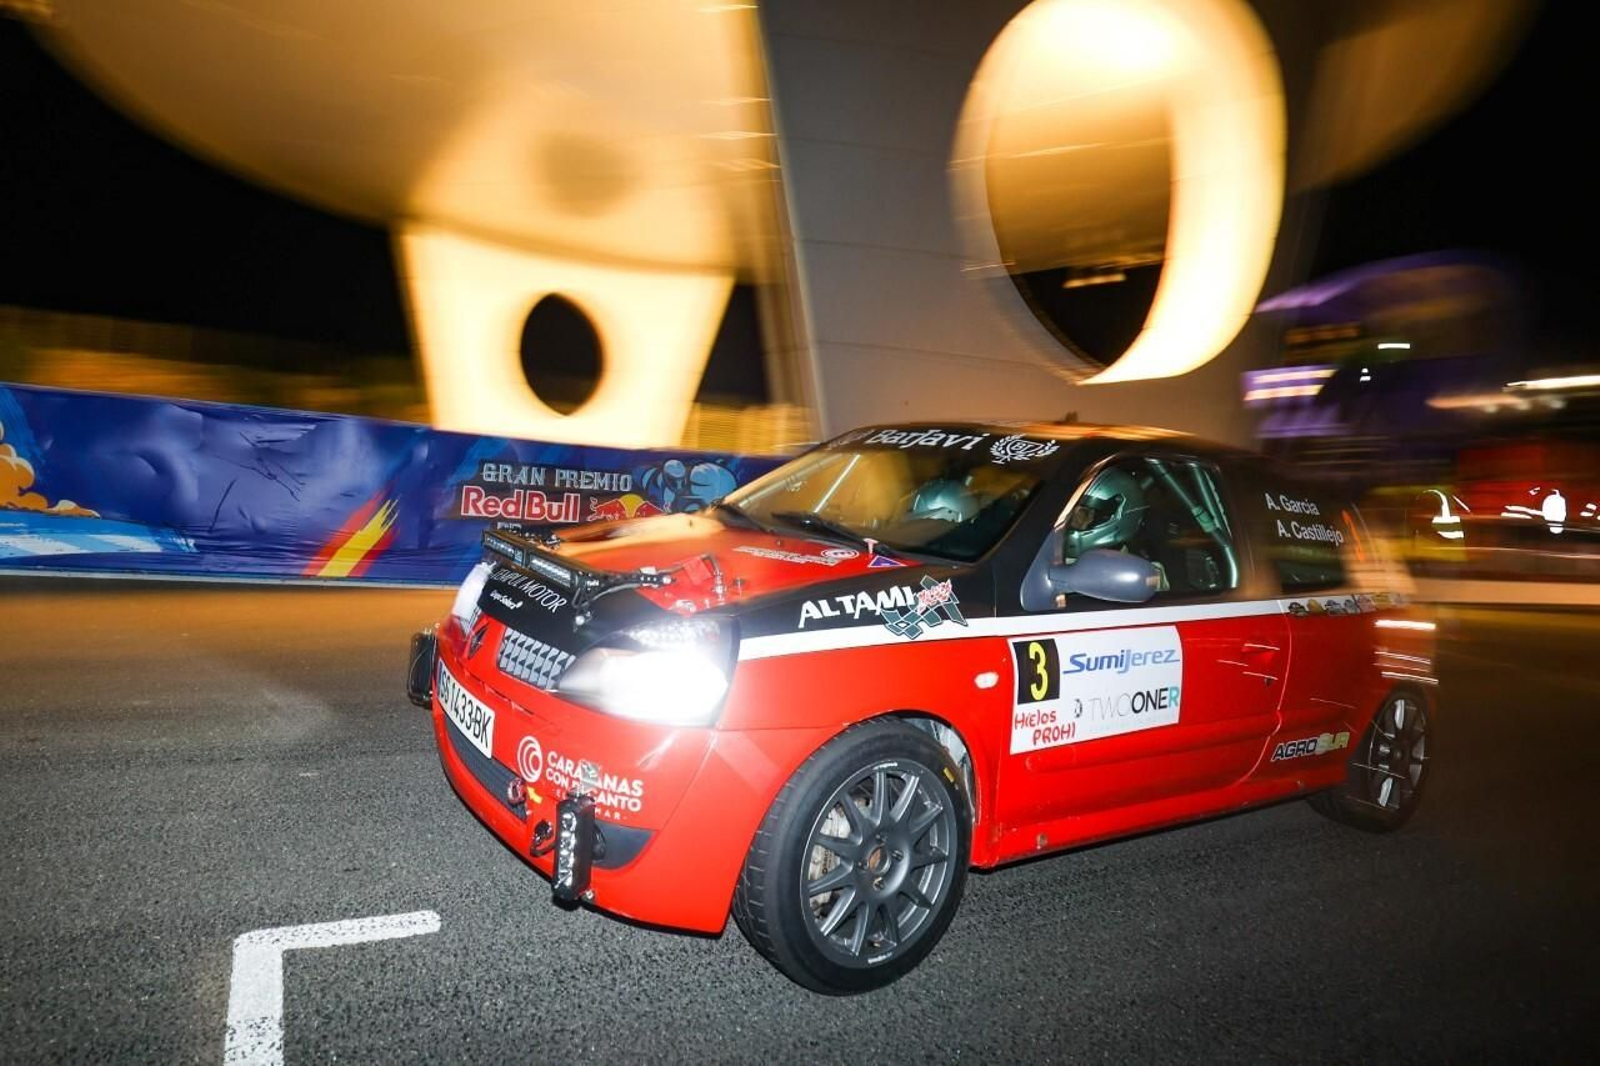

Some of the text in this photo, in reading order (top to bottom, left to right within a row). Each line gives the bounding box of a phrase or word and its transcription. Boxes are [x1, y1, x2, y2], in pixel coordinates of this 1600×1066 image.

[483, 463, 632, 492] GRAN PREMIO
[461, 485, 580, 523] Red Bull
[1265, 493, 1280, 511] A.
[1277, 519, 1344, 547] A. Castillejo
[518, 579, 567, 613] MOTOR
[1028, 641, 1049, 701] 3
[1062, 649, 1181, 674] SumiJerez
[545, 768, 569, 789] CON
[547, 751, 644, 798] CARANAS
